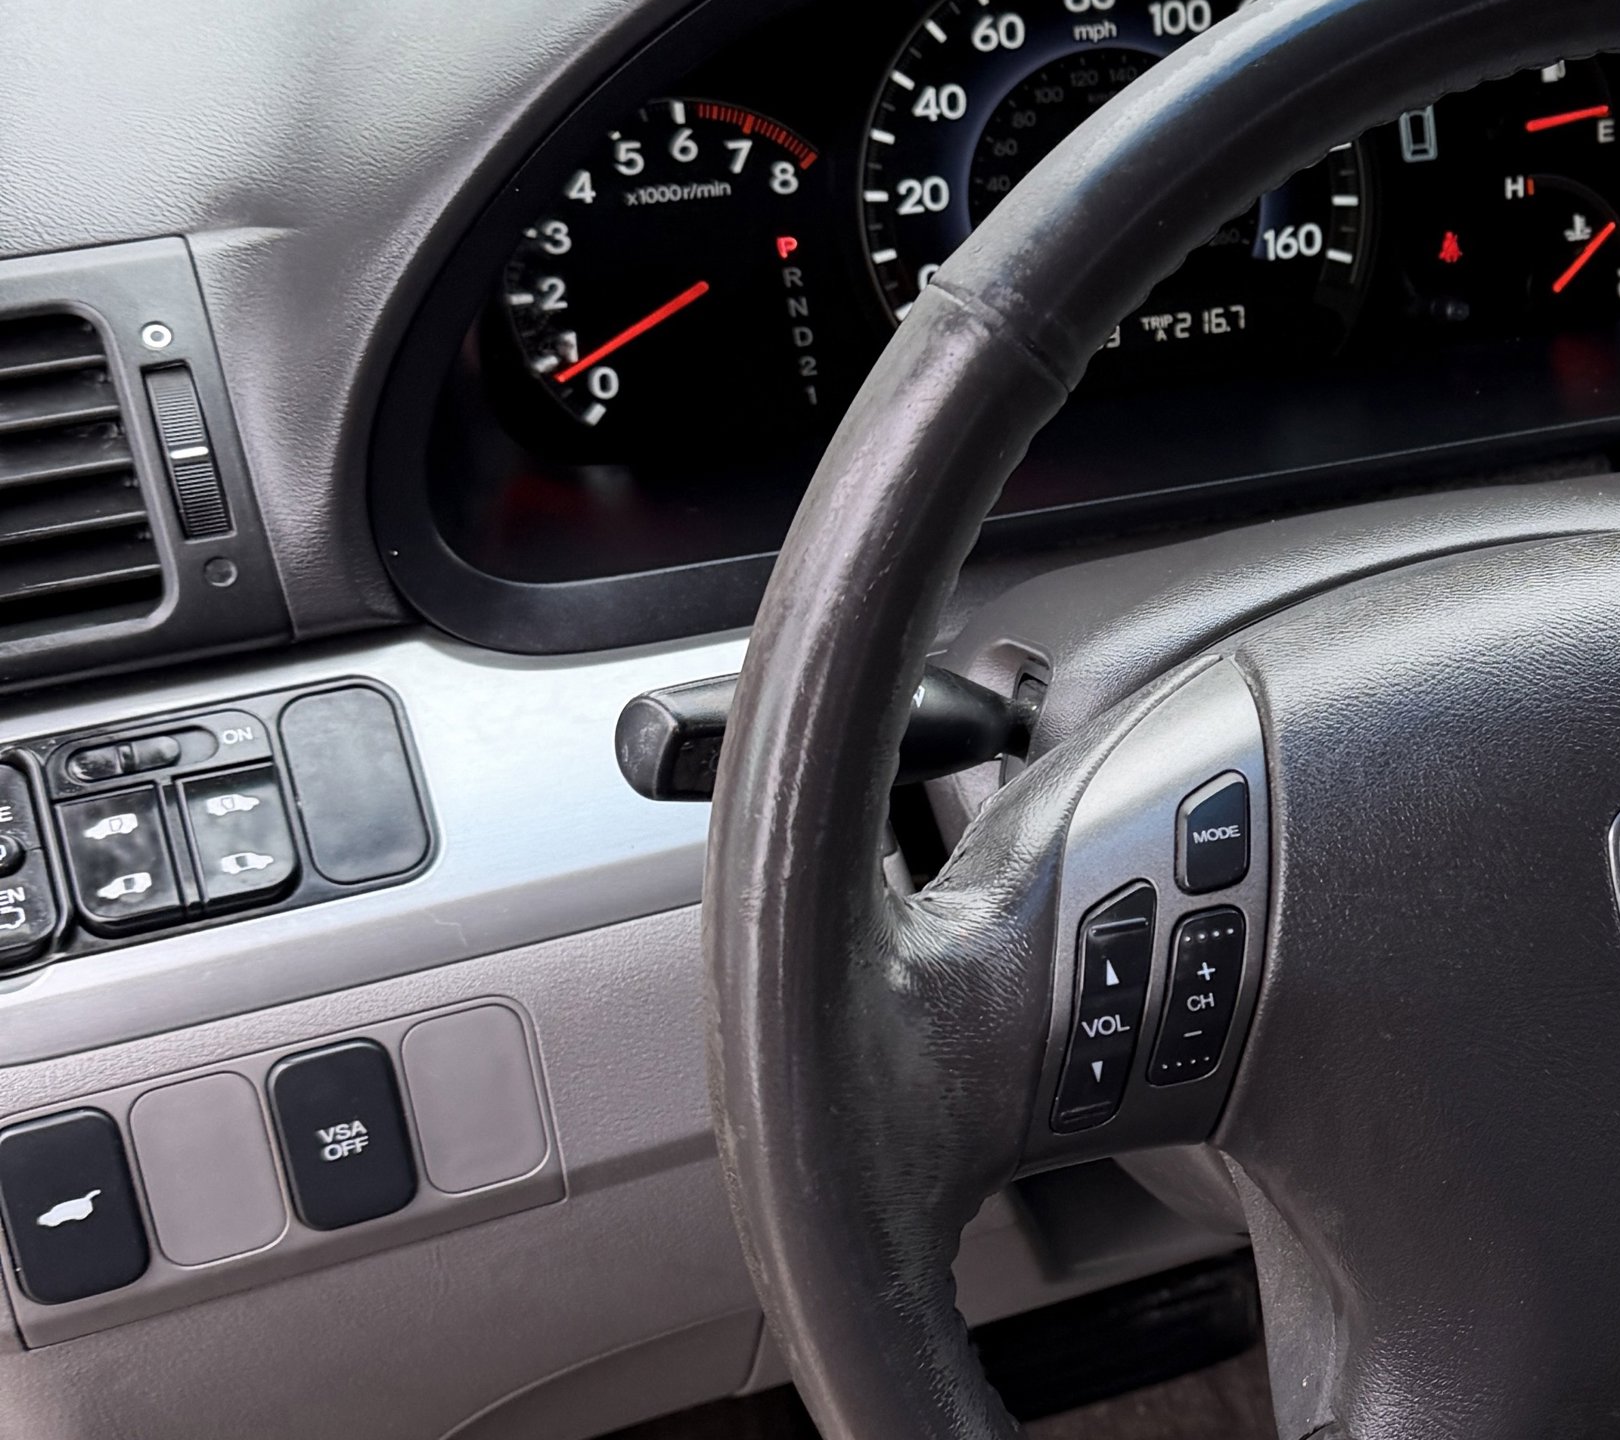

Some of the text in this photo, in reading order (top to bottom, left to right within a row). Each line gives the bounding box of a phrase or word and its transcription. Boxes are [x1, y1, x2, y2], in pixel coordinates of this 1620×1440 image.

[971, 14, 1025, 52] 60
[1073, 21, 1117, 43] mph
[913, 84, 967, 122] 40
[1598, 119, 1615, 143] E
[669, 128, 698, 162] 6
[725, 139, 753, 174] 7
[615, 140, 645, 176] 5
[566, 170, 596, 204] 4
[770, 161, 799, 194] 8
[1504, 175, 1524, 199] H
[897, 176, 949, 215] 20
[543, 220, 571, 254] 3
[776, 236, 798, 258] P
[1263, 223, 1322, 261] 160
[782, 267, 803, 288] R
[540, 277, 568, 310] 2
[787, 297, 808, 317] N
[1141, 313, 1173, 331] TRIP
[793, 327, 814, 347] D
[1155, 329, 1168, 342] A
[800, 356, 817, 376] 2
[588, 366, 620, 399] 0
[807, 385, 818, 405] 1
[222, 727, 253, 745] ON
[1192, 824, 1241, 844] MODE
[1186, 992, 1215, 1013] CH
[1081, 1014, 1130, 1038] VOL
[316, 1119, 367, 1144] VSA
[322, 1134, 369, 1161] OFF
